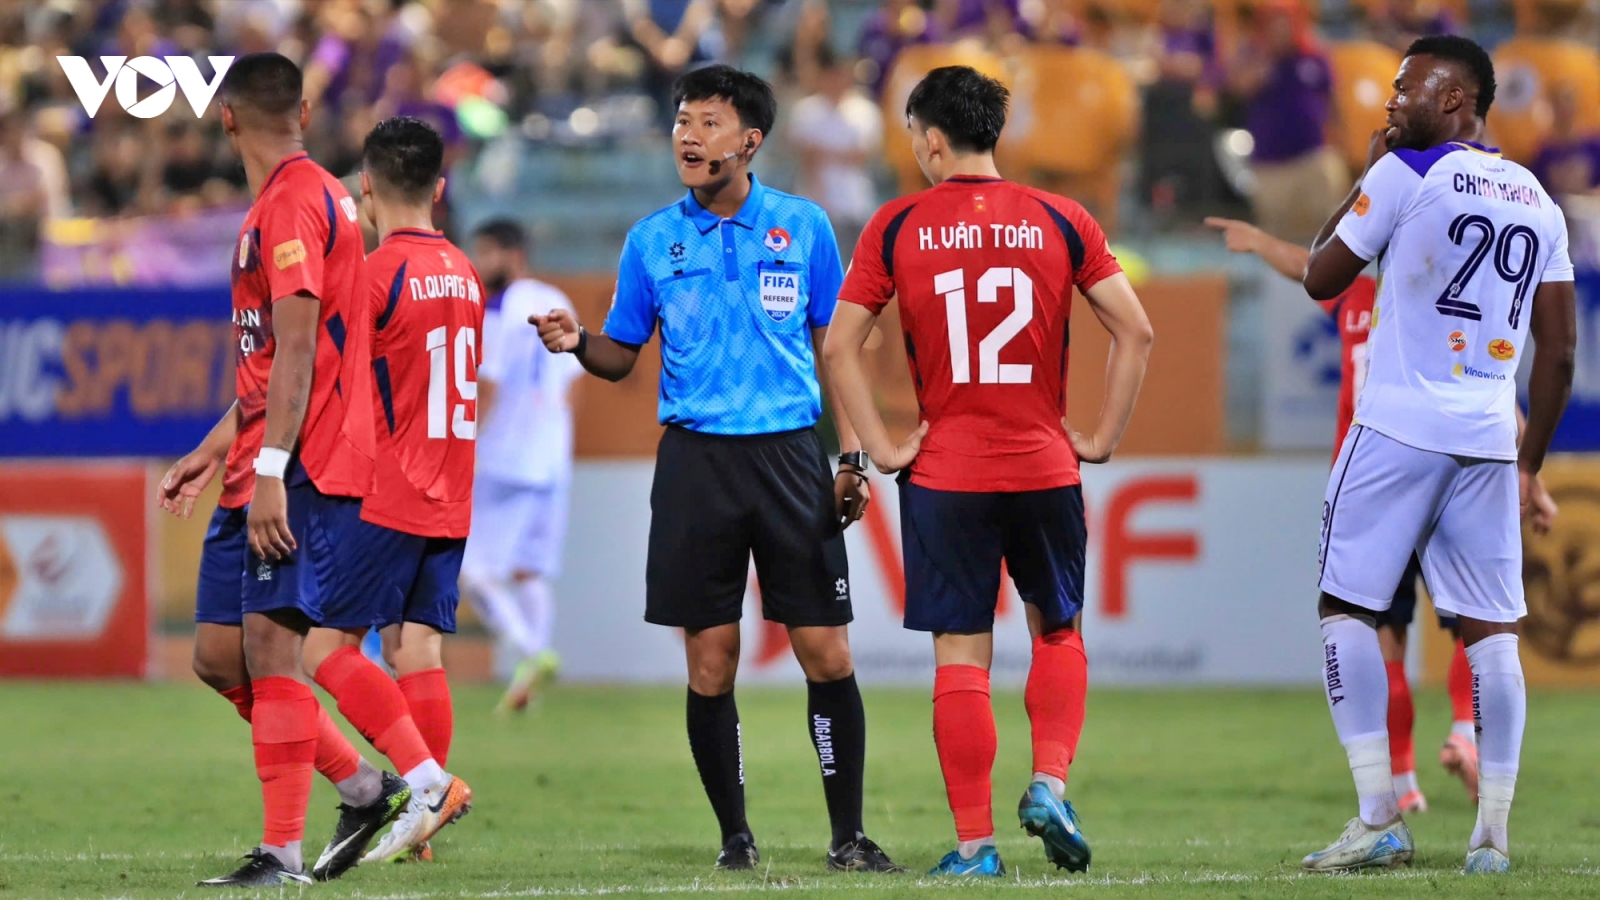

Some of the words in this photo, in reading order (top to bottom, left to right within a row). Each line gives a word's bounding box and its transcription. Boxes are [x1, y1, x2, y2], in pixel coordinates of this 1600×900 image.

[1453, 173, 1497, 200] CHIDI
[919, 221, 982, 250] H.VĂN
[990, 220, 1043, 250] TOẢN
[763, 276, 795, 288] FIFA
[1435, 213, 1540, 330] 29
[409, 274, 466, 301] N.QUANG
[763, 295, 794, 303] REFEREE
[934, 267, 1033, 383] 12
[239, 330, 254, 357] ỘI
[426, 325, 477, 440] 19
[1325, 643, 1345, 706] JOGARBOLA
[813, 714, 836, 776] JOGARBOLA
